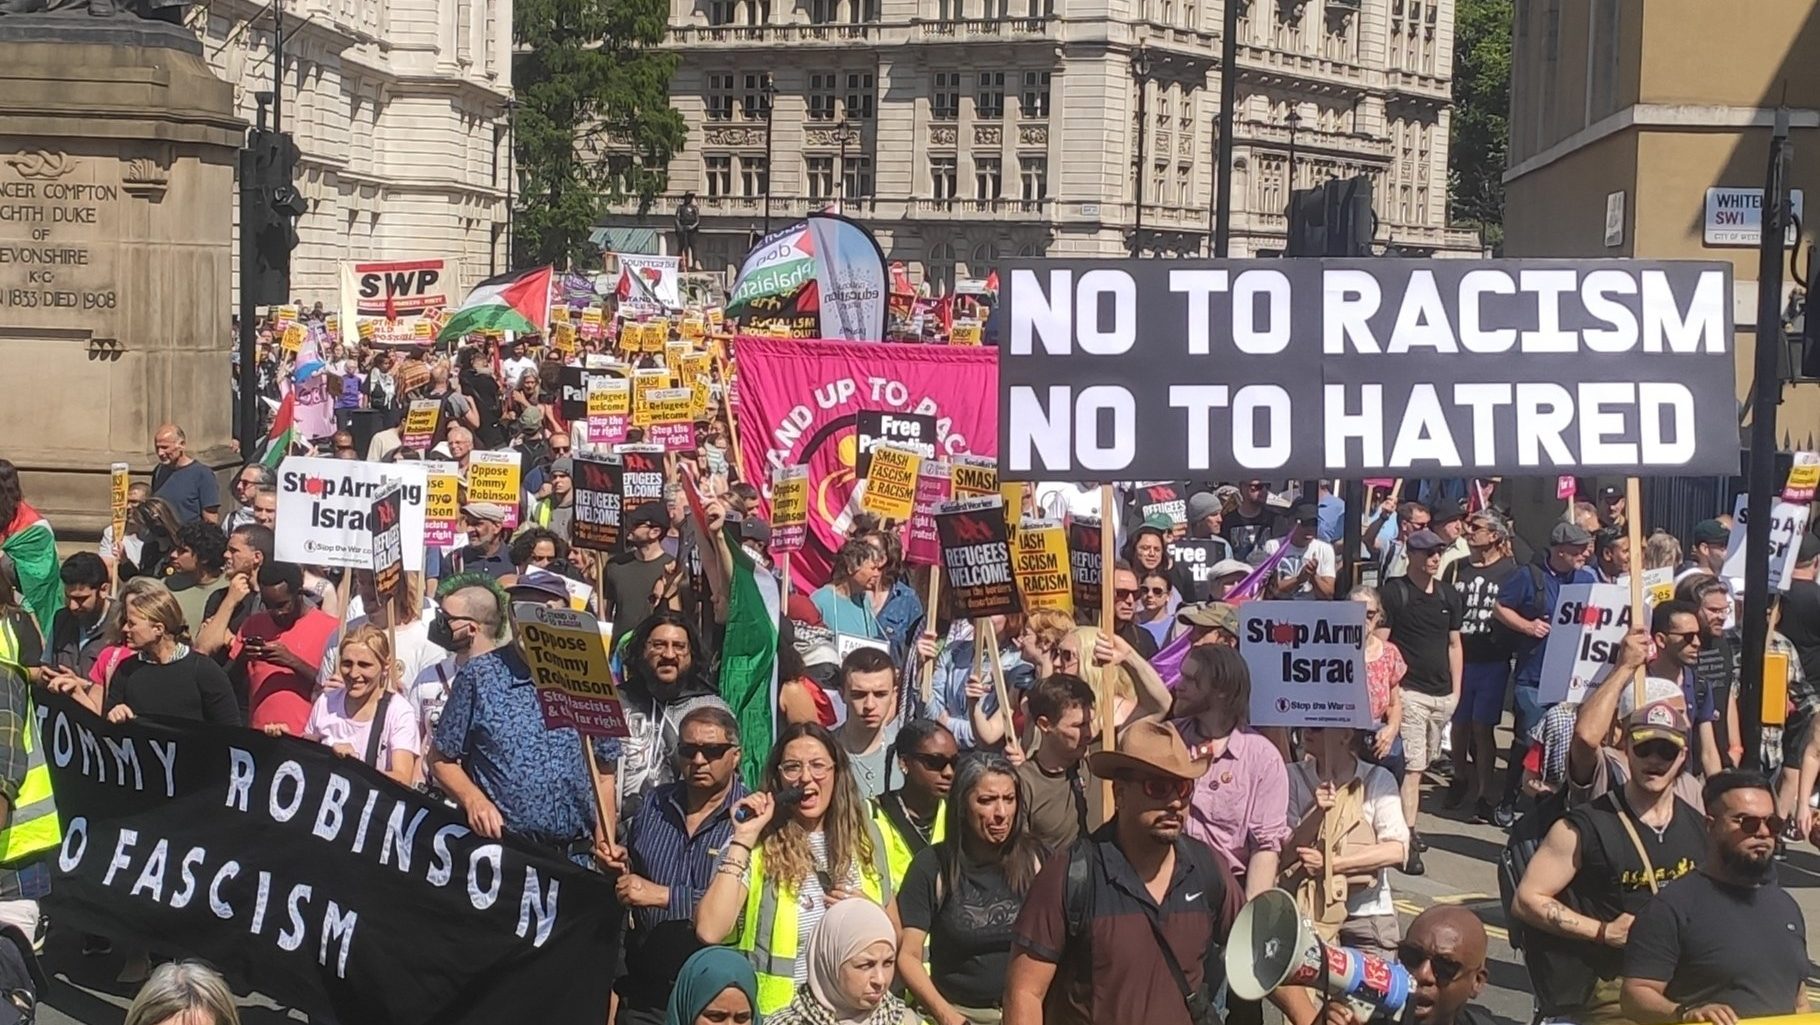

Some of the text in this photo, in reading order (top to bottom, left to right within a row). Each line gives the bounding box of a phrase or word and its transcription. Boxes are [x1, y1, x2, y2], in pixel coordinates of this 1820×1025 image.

[43, 183, 117, 201] COMPTON
[52, 207, 96, 223] DUKE
[32, 229, 50, 241] OF
[359, 269, 439, 298] SWP
[43, 291, 77, 307] DIED
[83, 291, 117, 309] 1908
[1009, 269, 1726, 355] NO TO RACISM
[590, 392, 627, 403] Refugees
[813, 376, 909, 409] UP TO
[590, 402, 625, 411] welcome
[649, 401, 690, 412] Refugees
[650, 410, 689, 419] welcome
[589, 415, 624, 425] Stop the
[881, 415, 921, 437] Free
[1009, 382, 1697, 471] NO TO HATRED
[602, 426, 622, 438] right
[651, 424, 689, 436] Stop the
[667, 434, 689, 446] right
[875, 448, 909, 467] SMASH
[471, 464, 509, 477] Oppose
[871, 463, 913, 484] FASCISM
[956, 468, 1000, 491] SMASH
[471, 476, 507, 490] Tommy
[866, 481, 876, 491] &
[880, 480, 913, 500] RACISM
[469, 489, 517, 501] Robinson
[575, 488, 621, 510] REFUGEES
[967, 499, 993, 510] Worker
[575, 504, 621, 526] WELCOME
[432, 530, 452, 540] right
[945, 541, 1009, 567] REFUGEES
[948, 562, 1012, 588] WELCOME
[1023, 573, 1069, 592] RACISM
[525, 625, 587, 652] Oppose
[530, 646, 589, 676] Tommy
[536, 667, 613, 696] Robinson
[1291, 701, 1311, 711] Stop
[1312, 701, 1326, 710] the
[1327, 702, 1345, 710] War
[548, 705, 558, 717] &
[575, 711, 591, 724] far
[594, 715, 624, 729] right
[225, 747, 560, 949] ROBINSON
[102, 828, 359, 980] FASCISM
